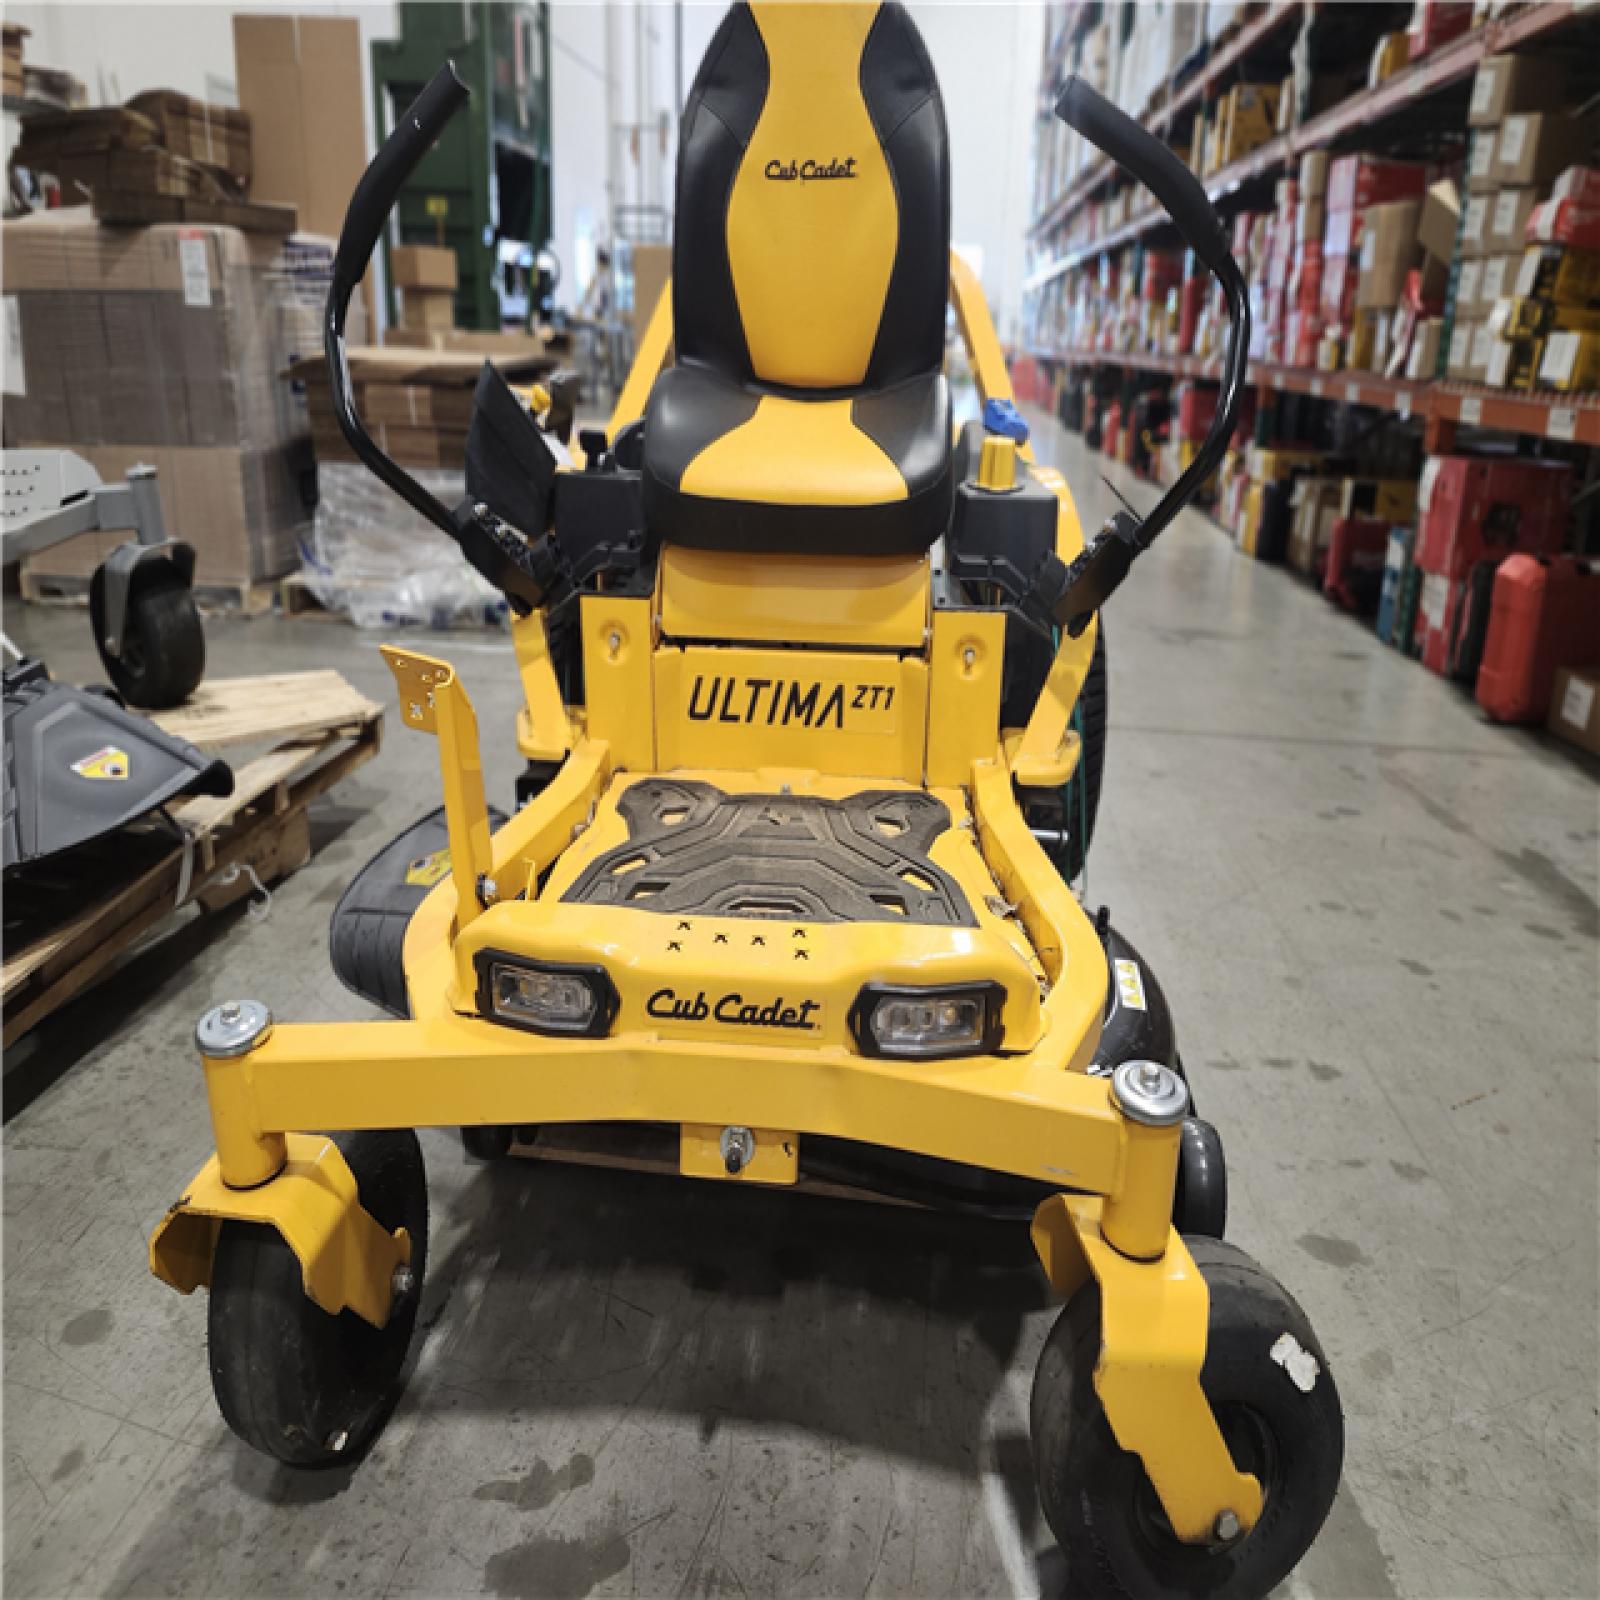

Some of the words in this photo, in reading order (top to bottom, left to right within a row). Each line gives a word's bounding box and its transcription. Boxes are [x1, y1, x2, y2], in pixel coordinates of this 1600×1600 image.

[765, 159, 798, 180] Cub
[800, 157, 858, 181] Cadet
[688, 675, 844, 728] ULTIMA
[851, 685, 895, 710] ZT1
[647, 989, 709, 1020] Cub
[713, 993, 820, 1030] Cadet
